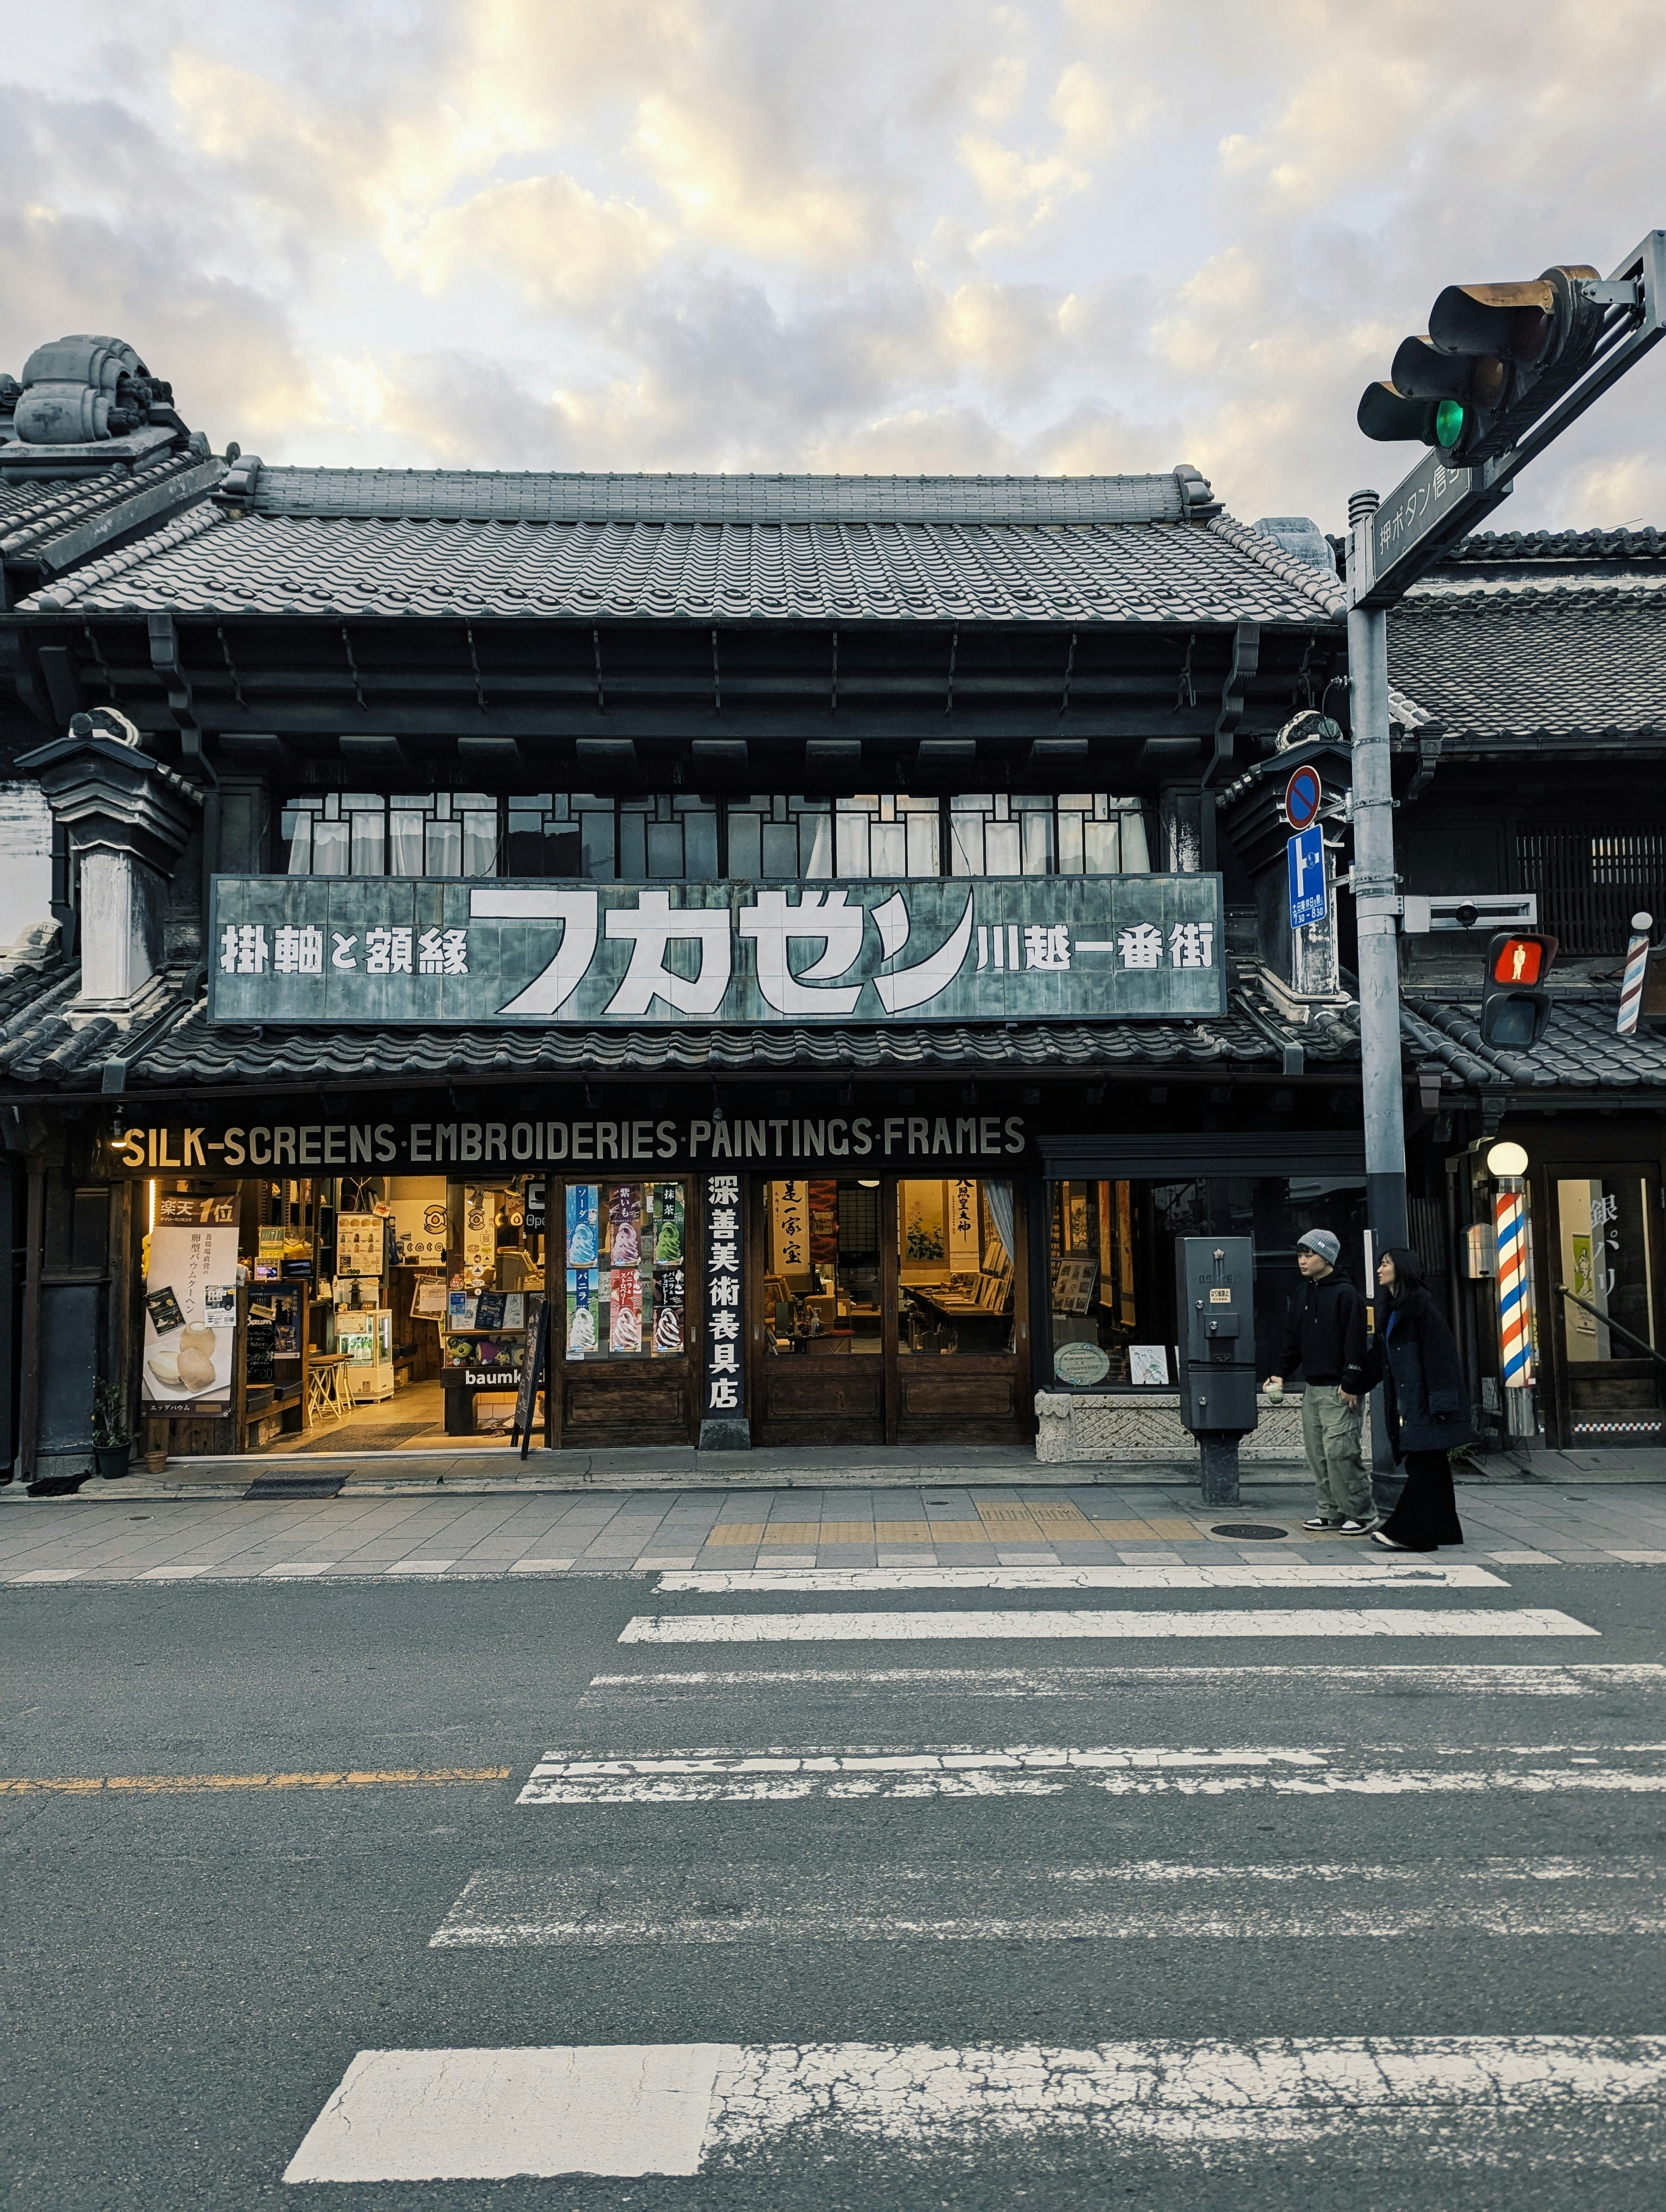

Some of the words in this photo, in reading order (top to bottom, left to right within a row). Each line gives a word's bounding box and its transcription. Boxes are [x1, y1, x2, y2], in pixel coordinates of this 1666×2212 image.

[219, 923, 470, 975] 掛軸と額縁
[470, 884, 976, 1015] フカゼン
[976, 923, 1214, 972] 川越一番街
[412, 1121, 677, 1162] EMBROIDERIES
[690, 1118, 873, 1158] PAINTINGS
[885, 1116, 1026, 1154] FRAMES
[161, 1200, 194, 1216] 楽天
[199, 1198, 233, 1223] 1位
[578, 1189, 588, 1219] ソーダ
[620, 1188, 630, 1217] 紫いも
[664, 1189, 675, 1215] 抹茶
[1590, 1194, 1620, 1298] 銀パリ
[185, 1233, 201, 1314] 卵型バウムクーヘン
[578, 1272, 588, 1301] バニラ
[707, 1175, 740, 1409] 深善美術表具店
[465, 1368, 545, 1385] baumk
